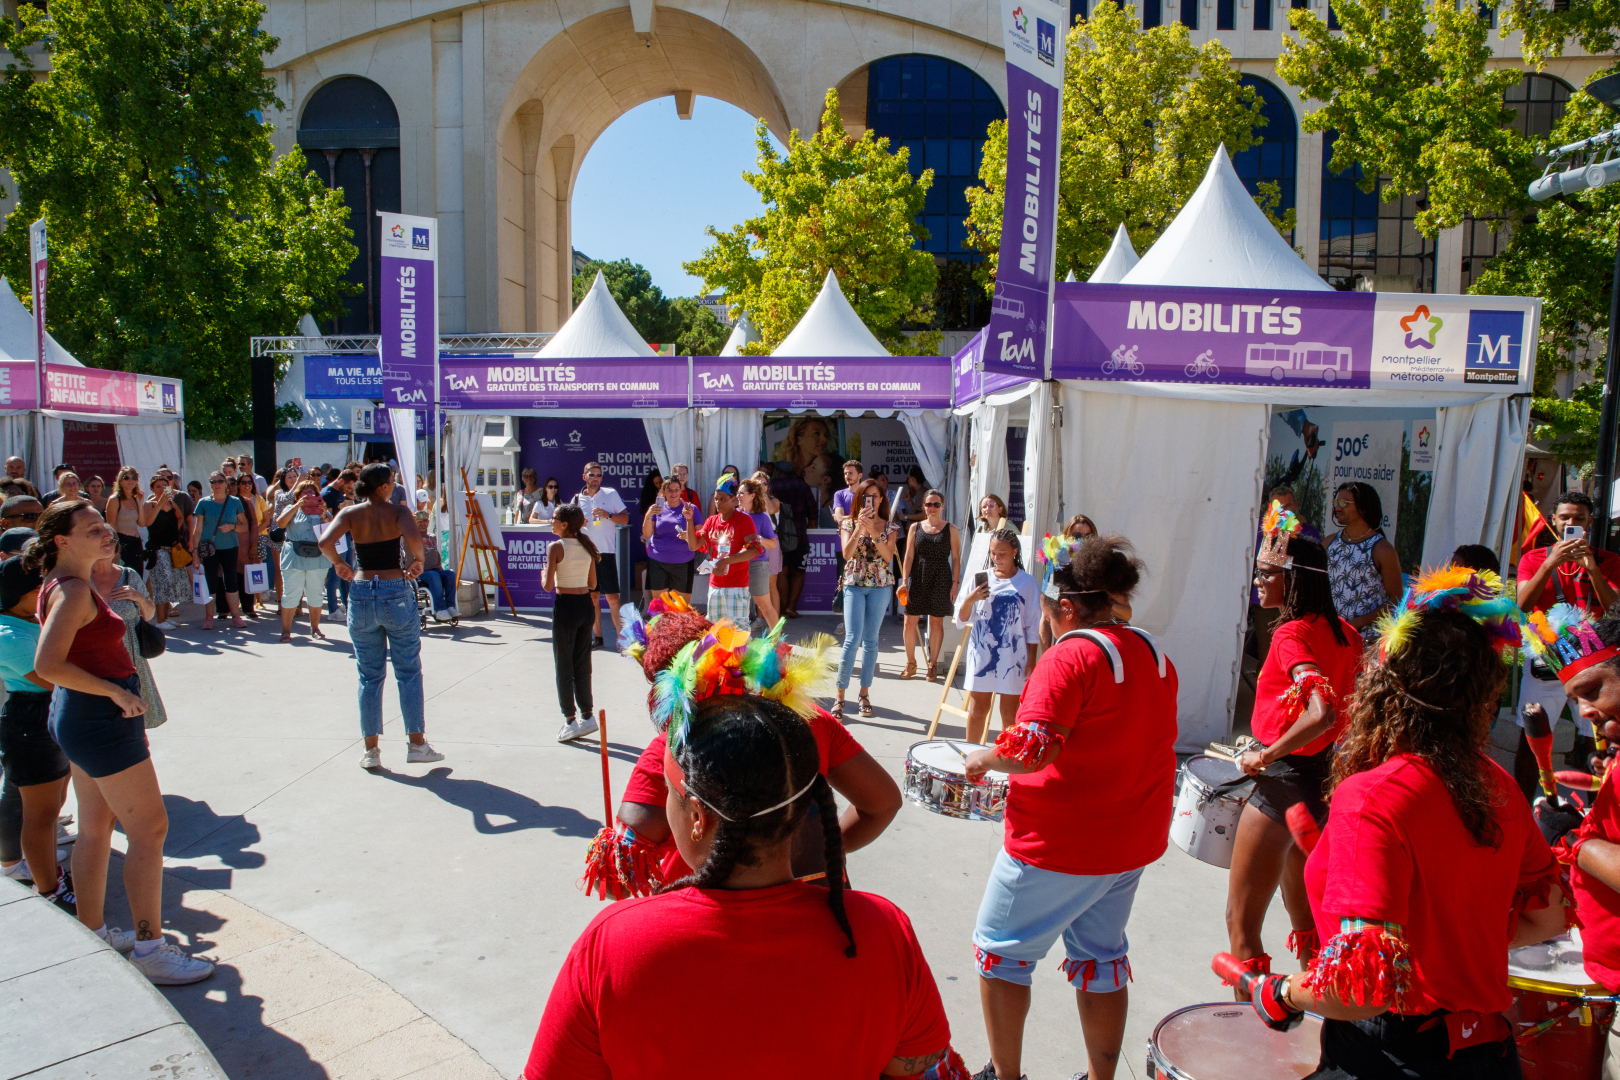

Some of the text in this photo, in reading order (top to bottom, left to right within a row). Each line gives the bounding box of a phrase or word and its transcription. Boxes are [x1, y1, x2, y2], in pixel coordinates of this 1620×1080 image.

[1041, 32, 1052, 54] M
[1020, 89, 1042, 276] MOBILITÉS
[416, 234, 426, 244] M
[397, 266, 416, 358] MOBILITÉS
[1126, 298, 1302, 336] MOBILITÉS
[1476, 334, 1511, 364] M
[1382, 354, 1442, 366] Montpellier
[328, 368, 344, 376] MA
[346, 368, 364, 377] VIE,
[487, 363, 576, 382] MOBILITÉS
[743, 362, 835, 381] MOBILITÉS
[1390, 372, 1445, 382] Métropole
[1466, 372, 1516, 382] Montpellier
[48, 371, 86, 389] PETITE
[743, 381, 786, 391] GRATUITÉ
[806, 382, 865, 390] TRANSPORTS
[880, 382, 921, 391] COMMUN
[487, 382, 528, 392] GRATUITÉ
[547, 383, 604, 391] TRANSPORTS
[606, 383, 618, 391] EN
[620, 382, 659, 391] COMMUN
[165, 394, 174, 406] M
[1335, 434, 1369, 461] 500€
[598, 452, 614, 463] EN
[601, 466, 632, 476] POUR
[1334, 464, 1395, 480] pour vous aider
[621, 478, 636, 488] DE
[508, 540, 555, 554] MOBI
[508, 554, 541, 562] GRATUITÉ
